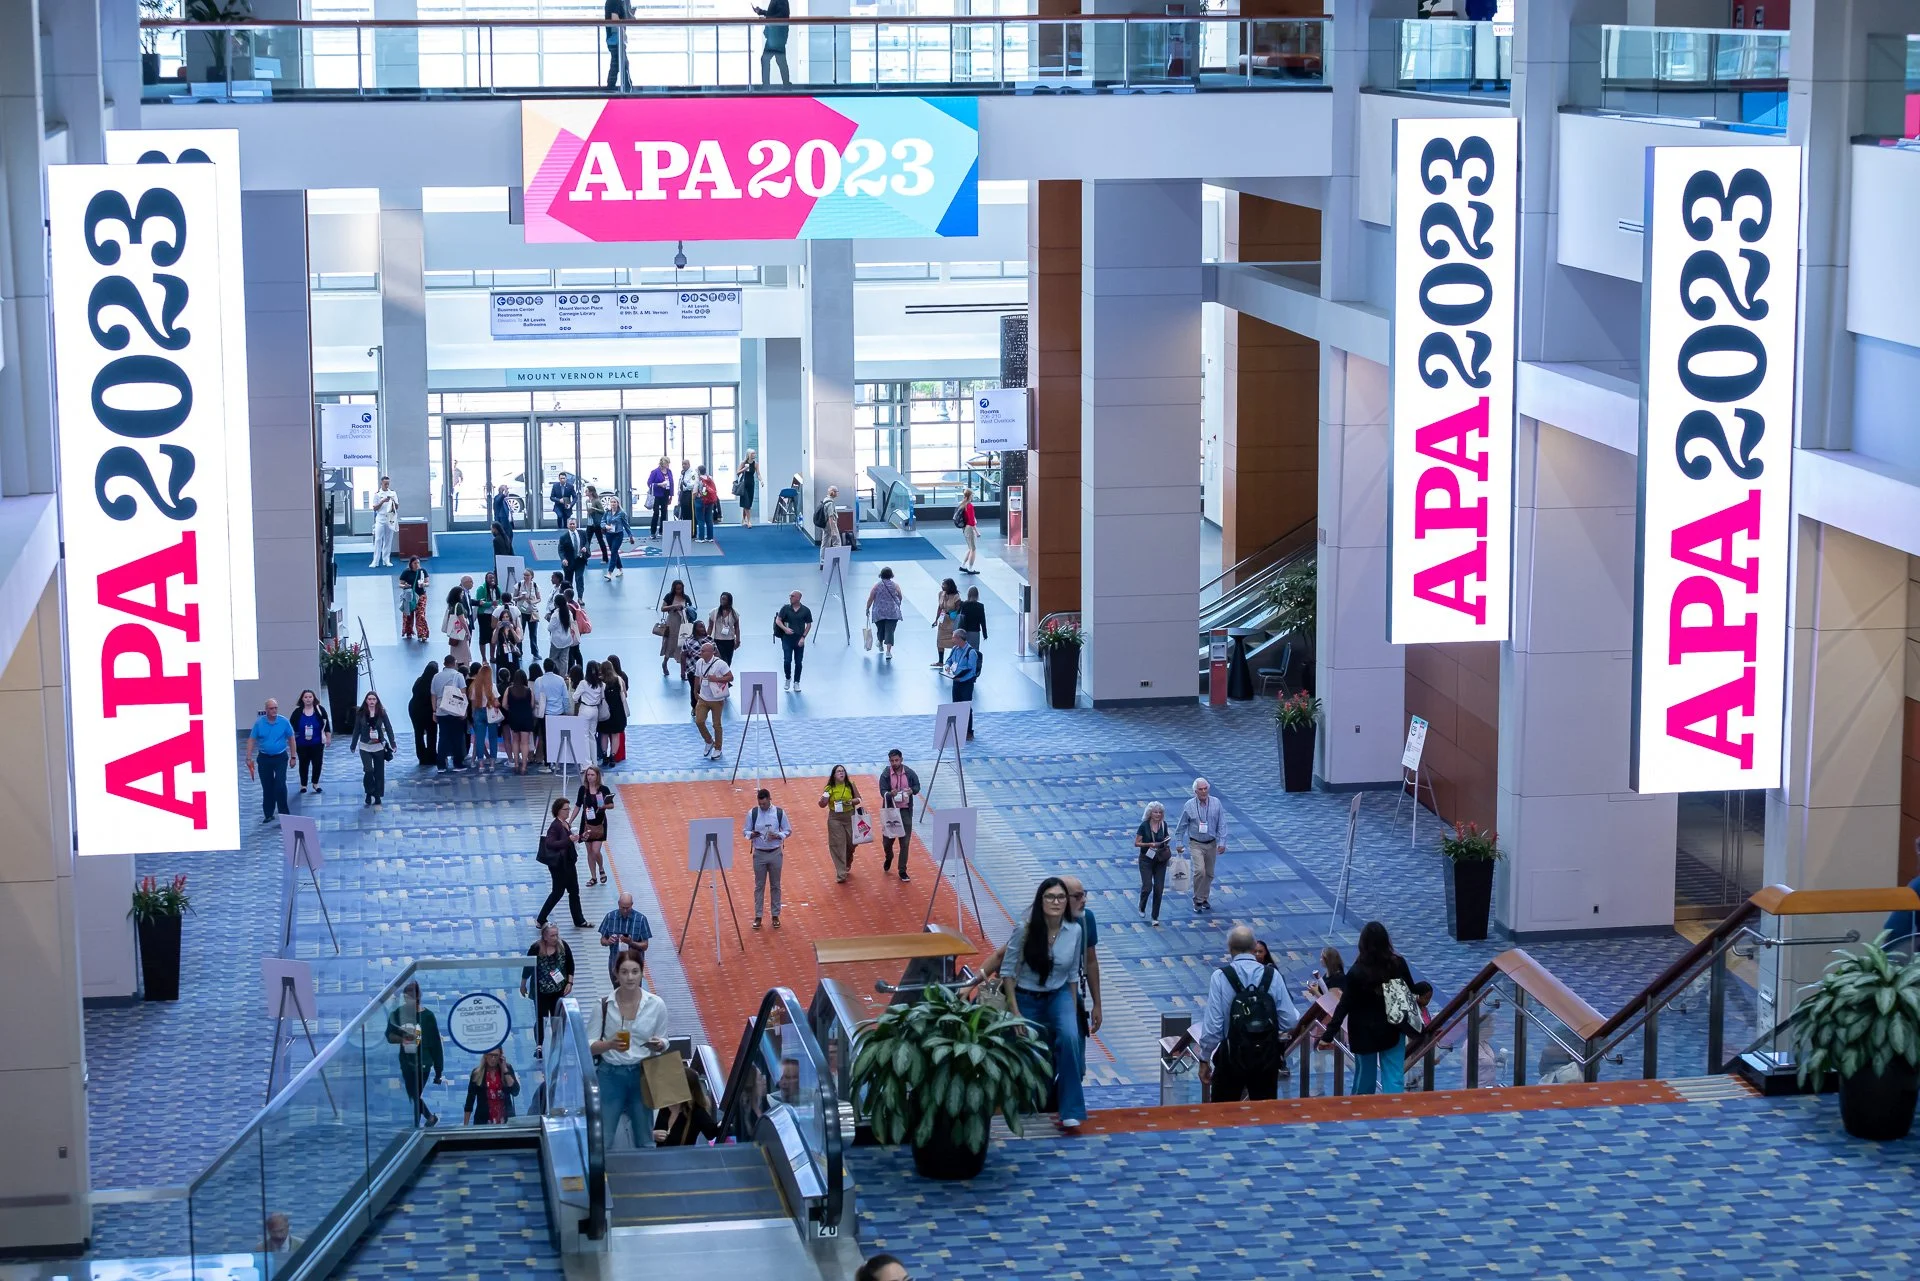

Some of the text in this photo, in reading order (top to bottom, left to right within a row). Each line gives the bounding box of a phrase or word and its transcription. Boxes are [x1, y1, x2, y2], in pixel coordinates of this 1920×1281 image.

[517, 371, 639, 381] MOUNT VERNON PLACE
